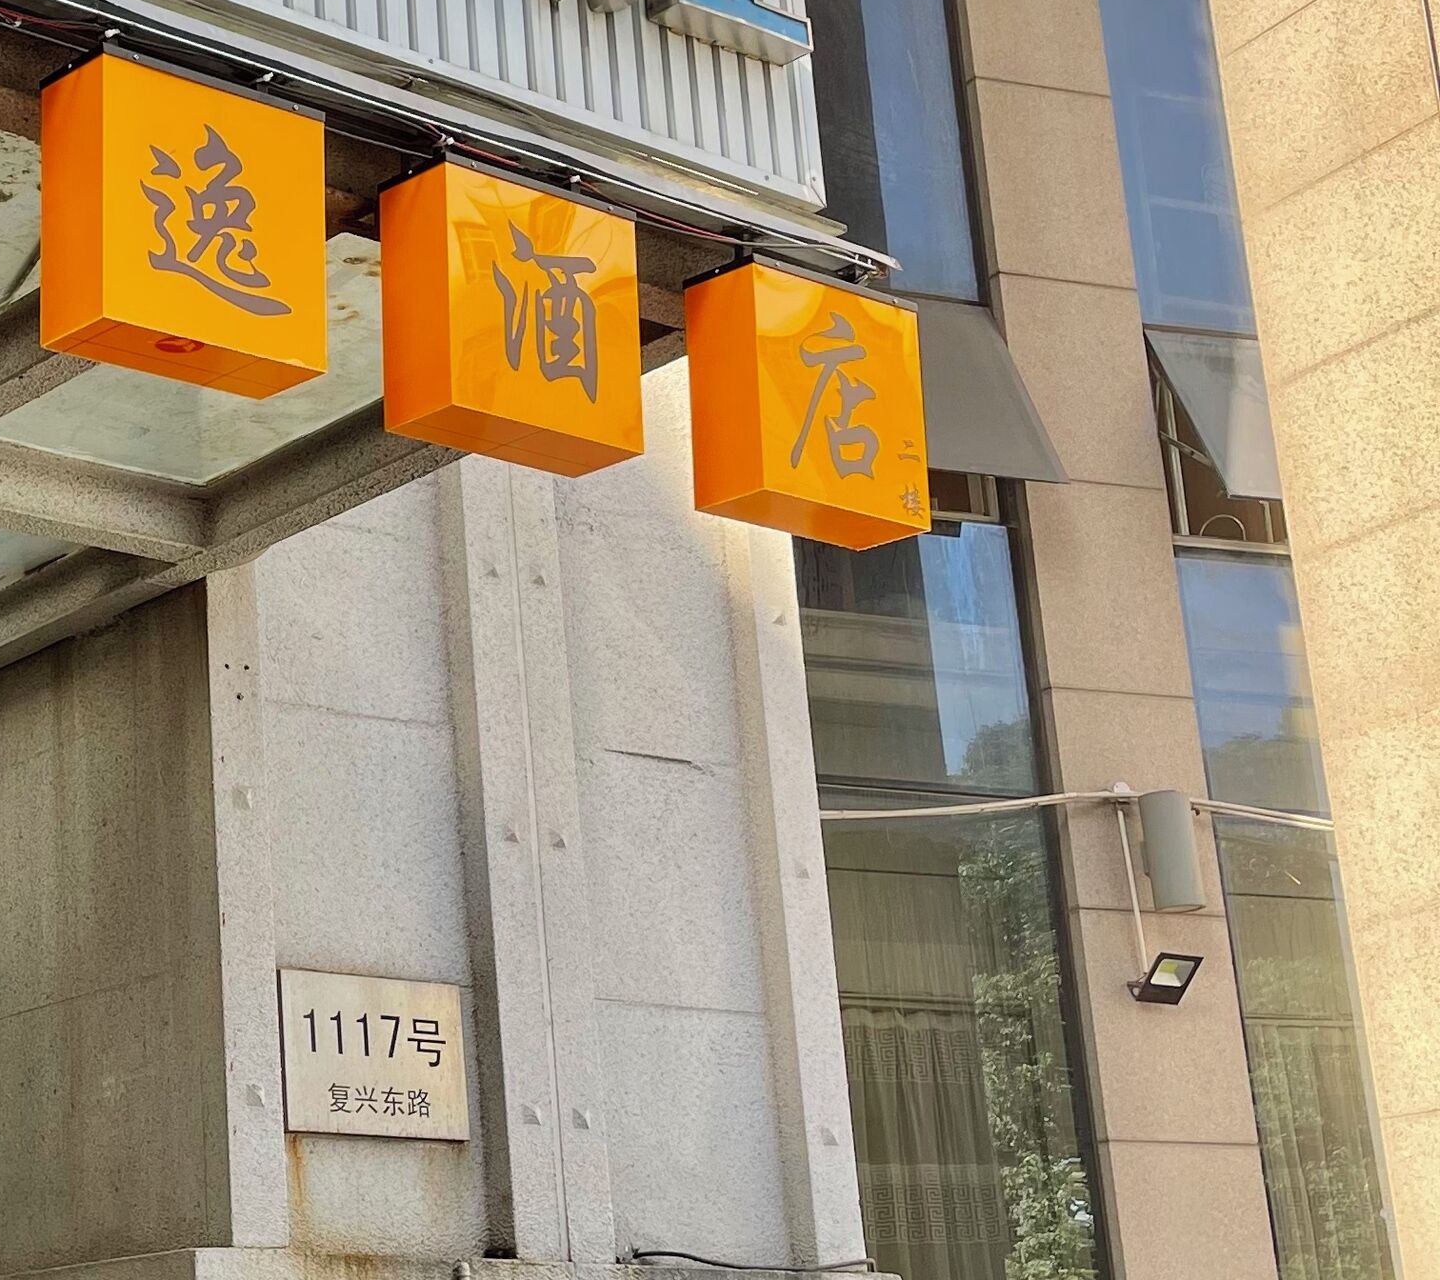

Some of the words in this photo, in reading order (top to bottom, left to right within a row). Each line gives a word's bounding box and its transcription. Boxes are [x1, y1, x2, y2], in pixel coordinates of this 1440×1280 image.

[896, 439, 926, 519] 二楼
[303, 1007, 447, 1068] 1117号
[327, 1081, 432, 1119] 复兴东路
